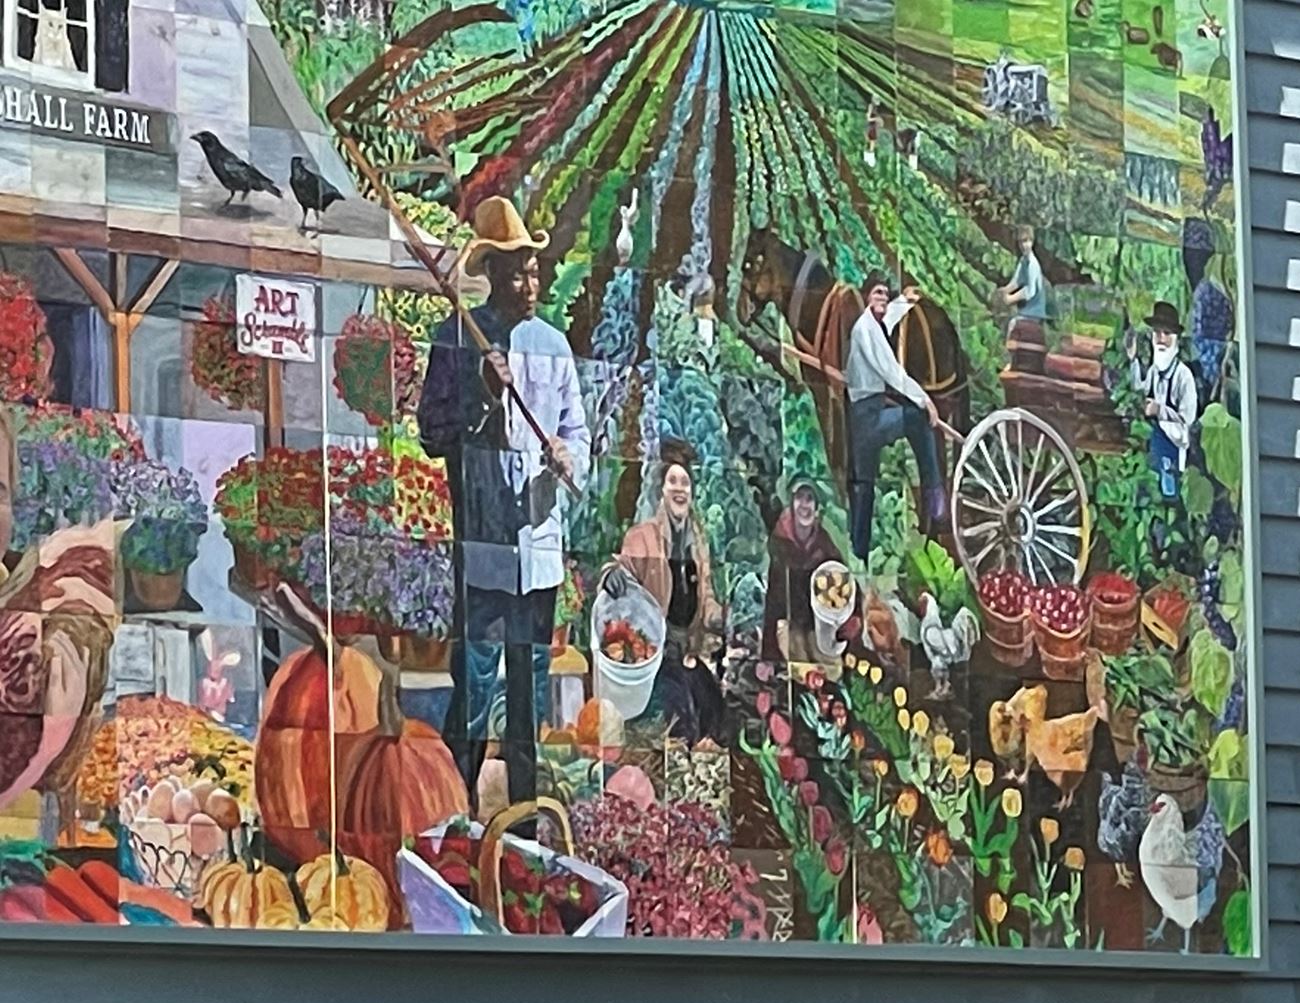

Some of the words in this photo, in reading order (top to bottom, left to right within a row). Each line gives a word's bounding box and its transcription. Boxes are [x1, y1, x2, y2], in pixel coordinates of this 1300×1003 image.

[0, 85, 74, 132] HALL
[83, 102, 151, 144] FARM
[255, 284, 300, 318] ART
